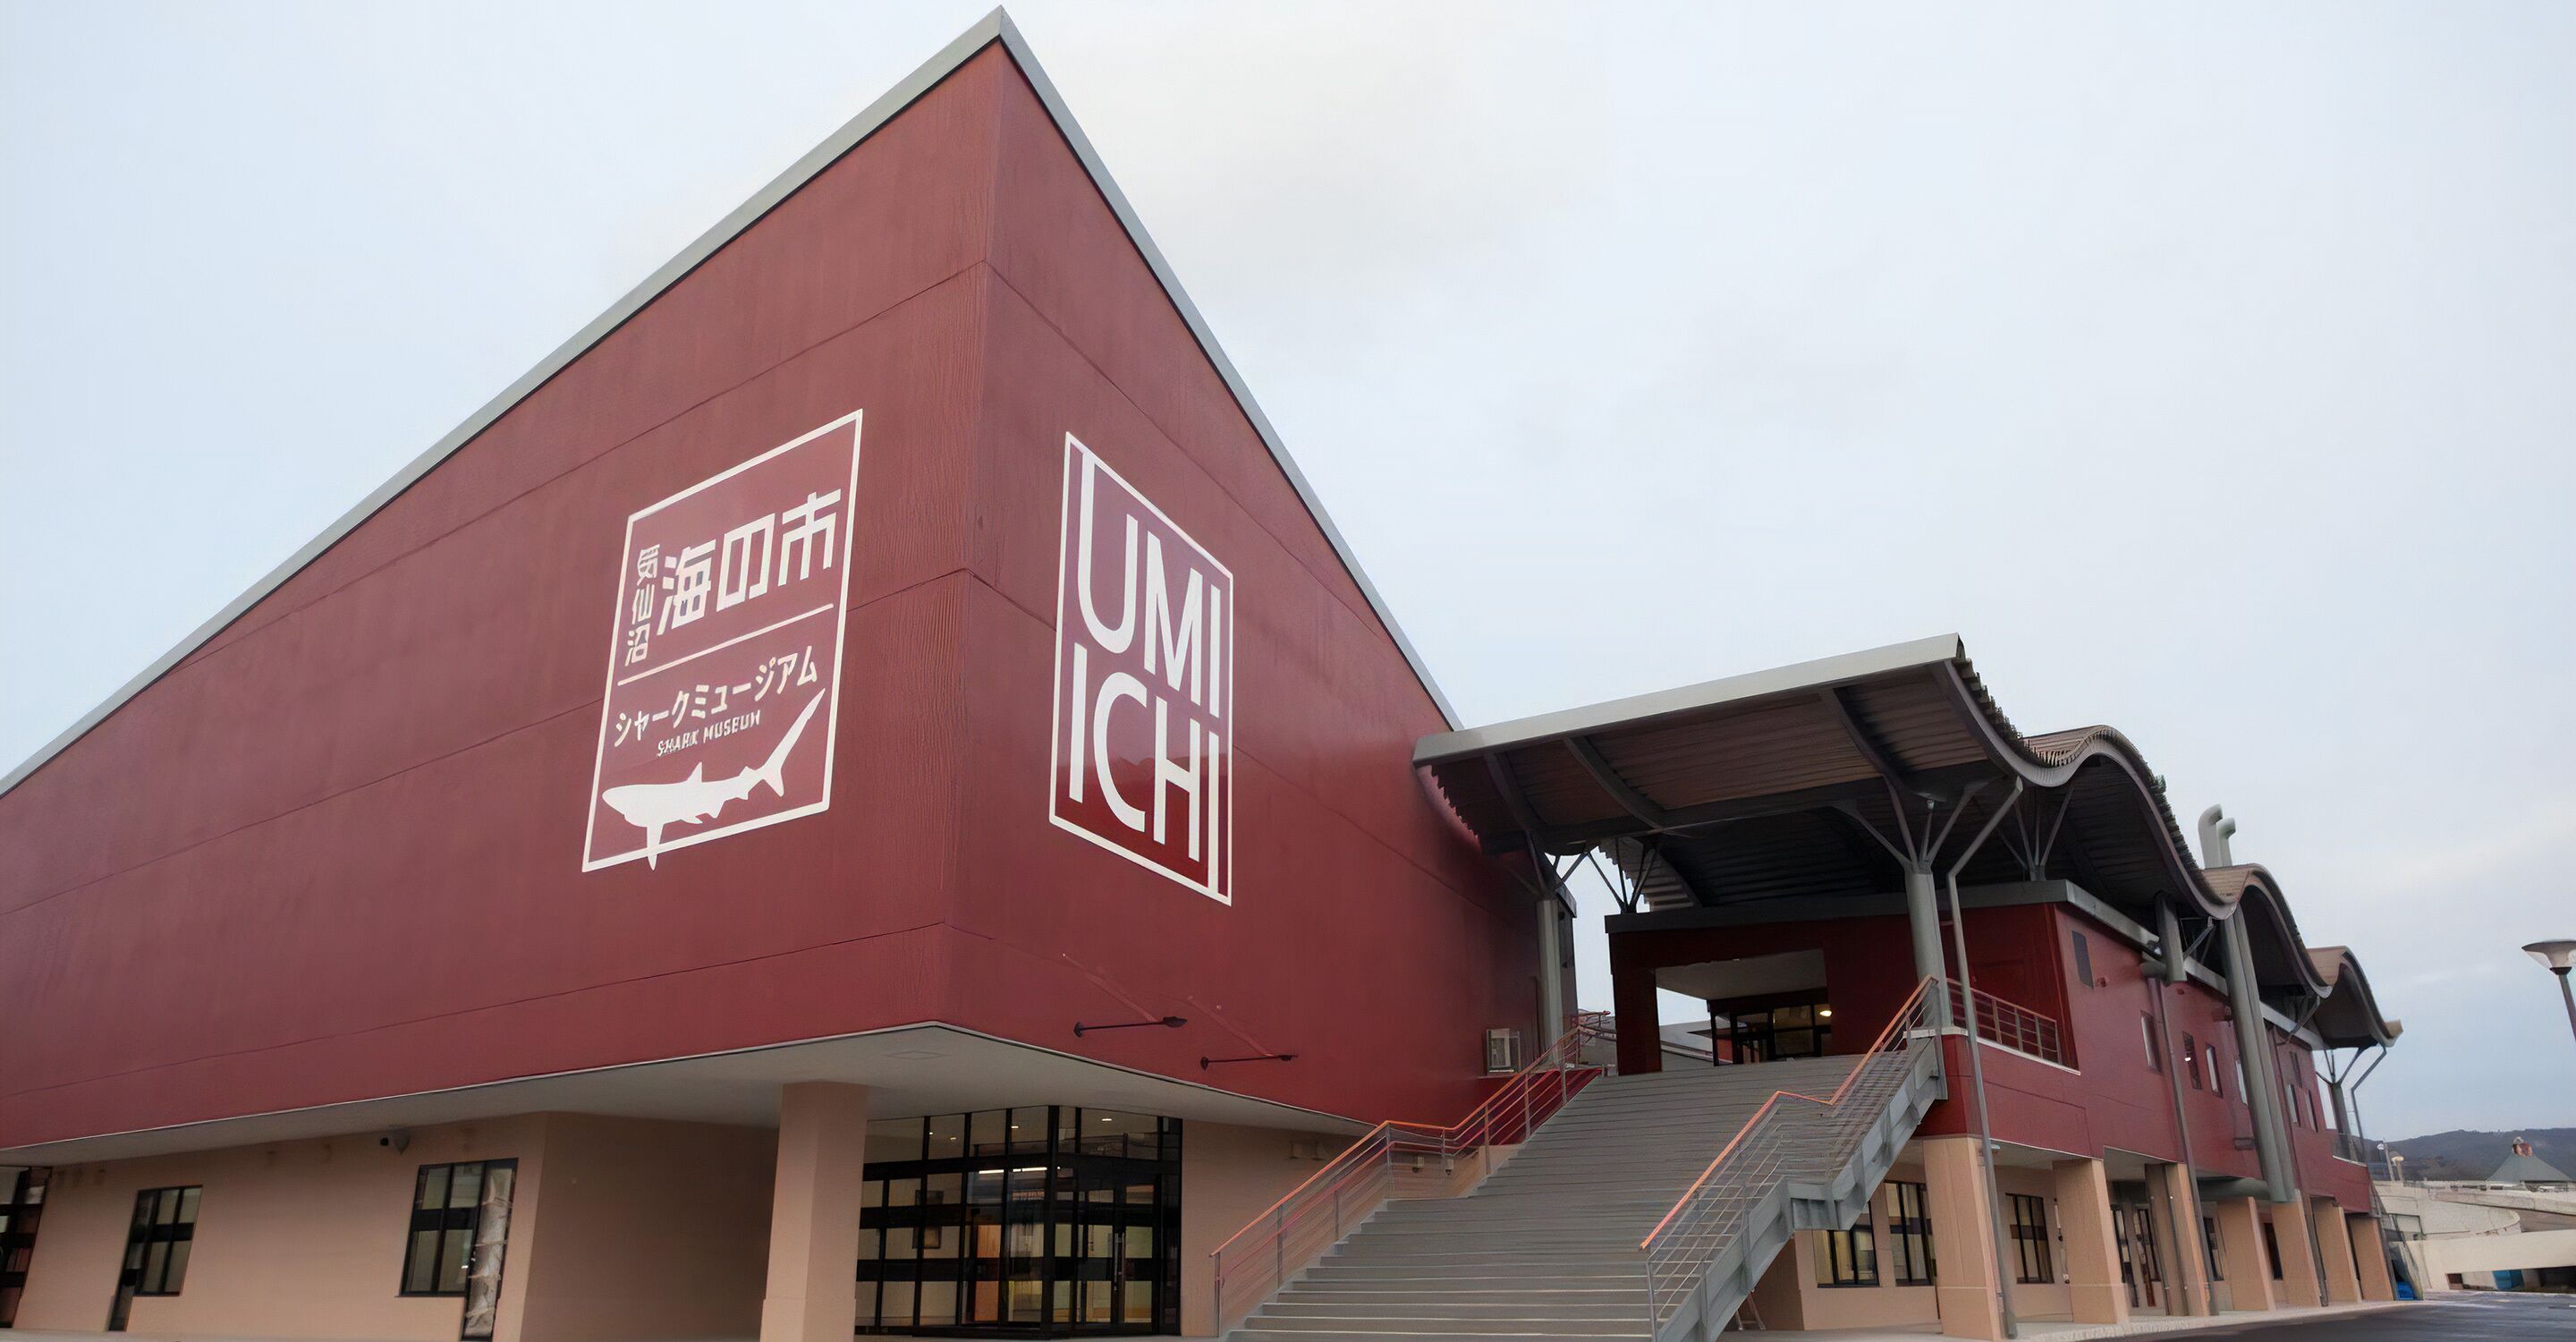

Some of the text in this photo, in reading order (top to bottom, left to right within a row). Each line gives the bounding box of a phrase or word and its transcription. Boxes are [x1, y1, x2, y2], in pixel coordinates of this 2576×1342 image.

[657, 489, 841, 635] 海の市
[1078, 452, 1220, 718] UMI
[614, 646, 818, 747] シャークミュージアム
[657, 709, 760, 757] SHARK MUSEUM
[1069, 641, 1219, 894] ICHI
